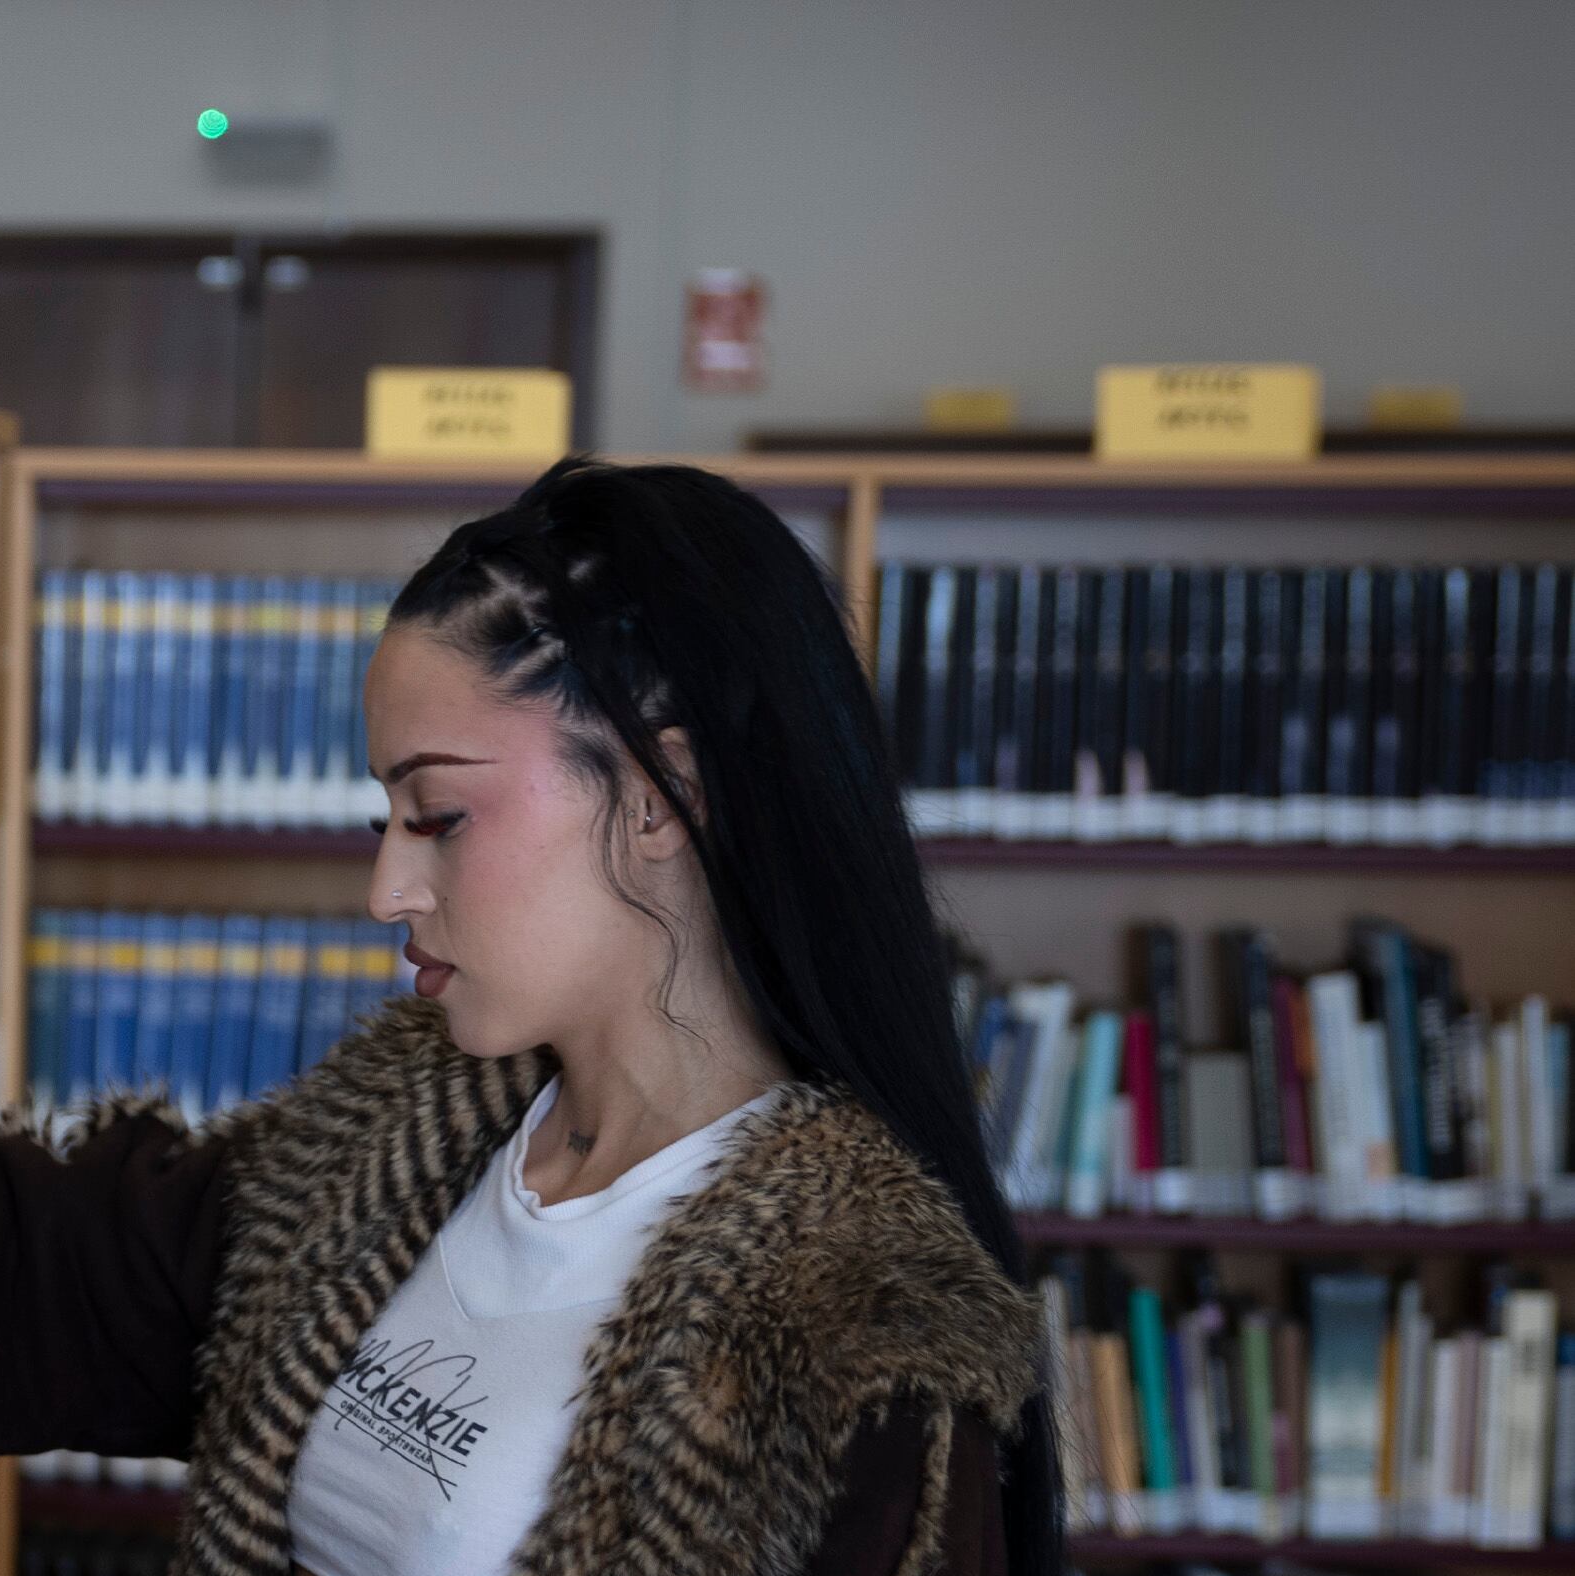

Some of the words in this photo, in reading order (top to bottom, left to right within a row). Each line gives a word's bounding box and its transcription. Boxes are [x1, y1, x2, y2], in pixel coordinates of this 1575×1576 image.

[340, 1353, 489, 1457] ACKENZIE
[340, 1400, 377, 1430] ORIGINAL
[377, 1425, 432, 1465] SPORTSWEAR
